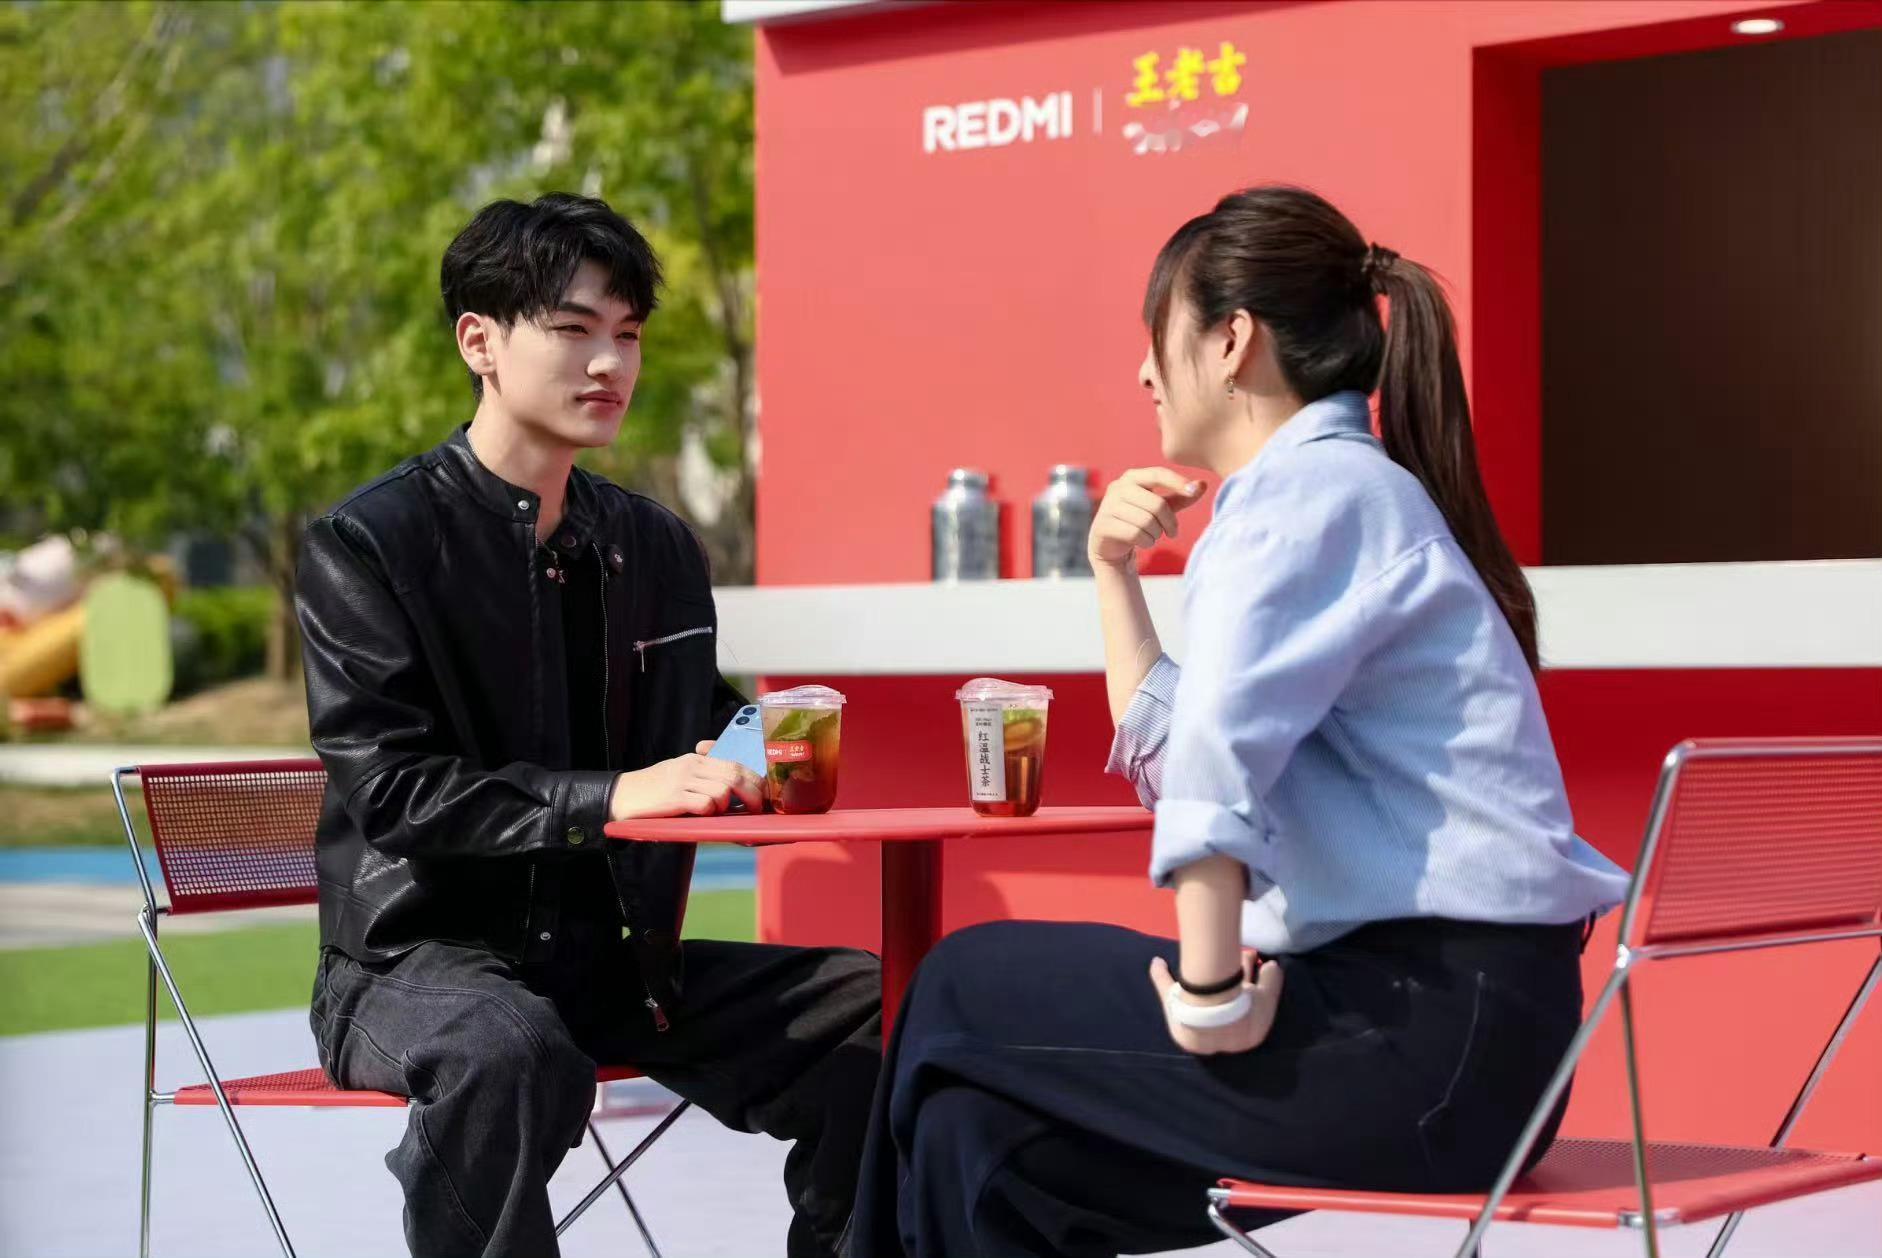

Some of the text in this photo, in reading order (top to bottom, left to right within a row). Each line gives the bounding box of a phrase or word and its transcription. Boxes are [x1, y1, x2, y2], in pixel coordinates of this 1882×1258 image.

[1125, 41, 1246, 107] 王老吉
[923, 91, 1073, 154] REDMI
